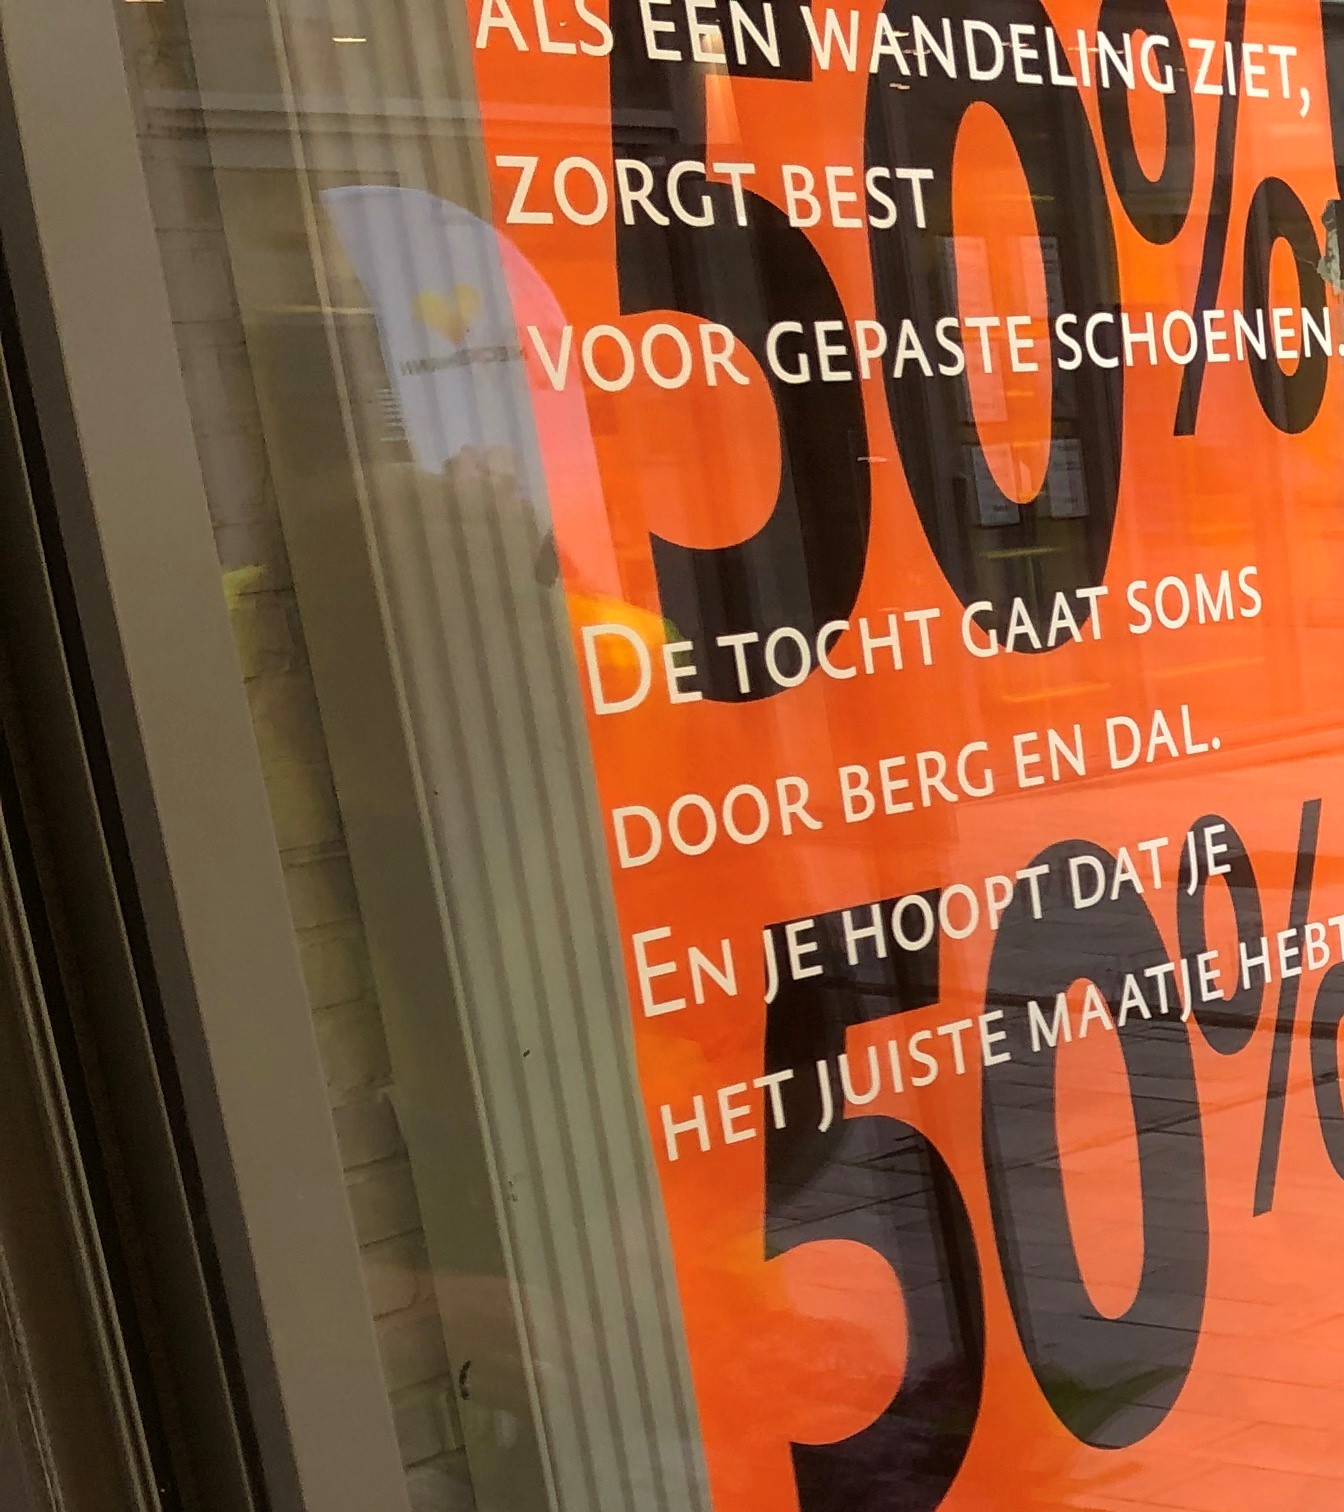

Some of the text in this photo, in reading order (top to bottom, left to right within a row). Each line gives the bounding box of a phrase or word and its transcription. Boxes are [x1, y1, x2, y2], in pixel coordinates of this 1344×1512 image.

[475, 0, 1312, 119] ALS EEN WANDELING ZIET,
[495, 153, 935, 230] ZORGT BEST
[526, 323, 750, 393] VOOR
[764, 314, 1039, 385] GEPASTE
[609, 0, 1330, 704] 50%
[581, 564, 1264, 717] DE TOCHT GAAT SOMS
[611, 702, 1222, 870] DOOR BERG EN DAL.
[633, 823, 1233, 1020] EN JE HOOPT DAT JE
[658, 1067, 795, 1164] HET
[814, 1008, 1013, 1136] JUISTE
[1027, 946, 1222, 1059] MAATJE
